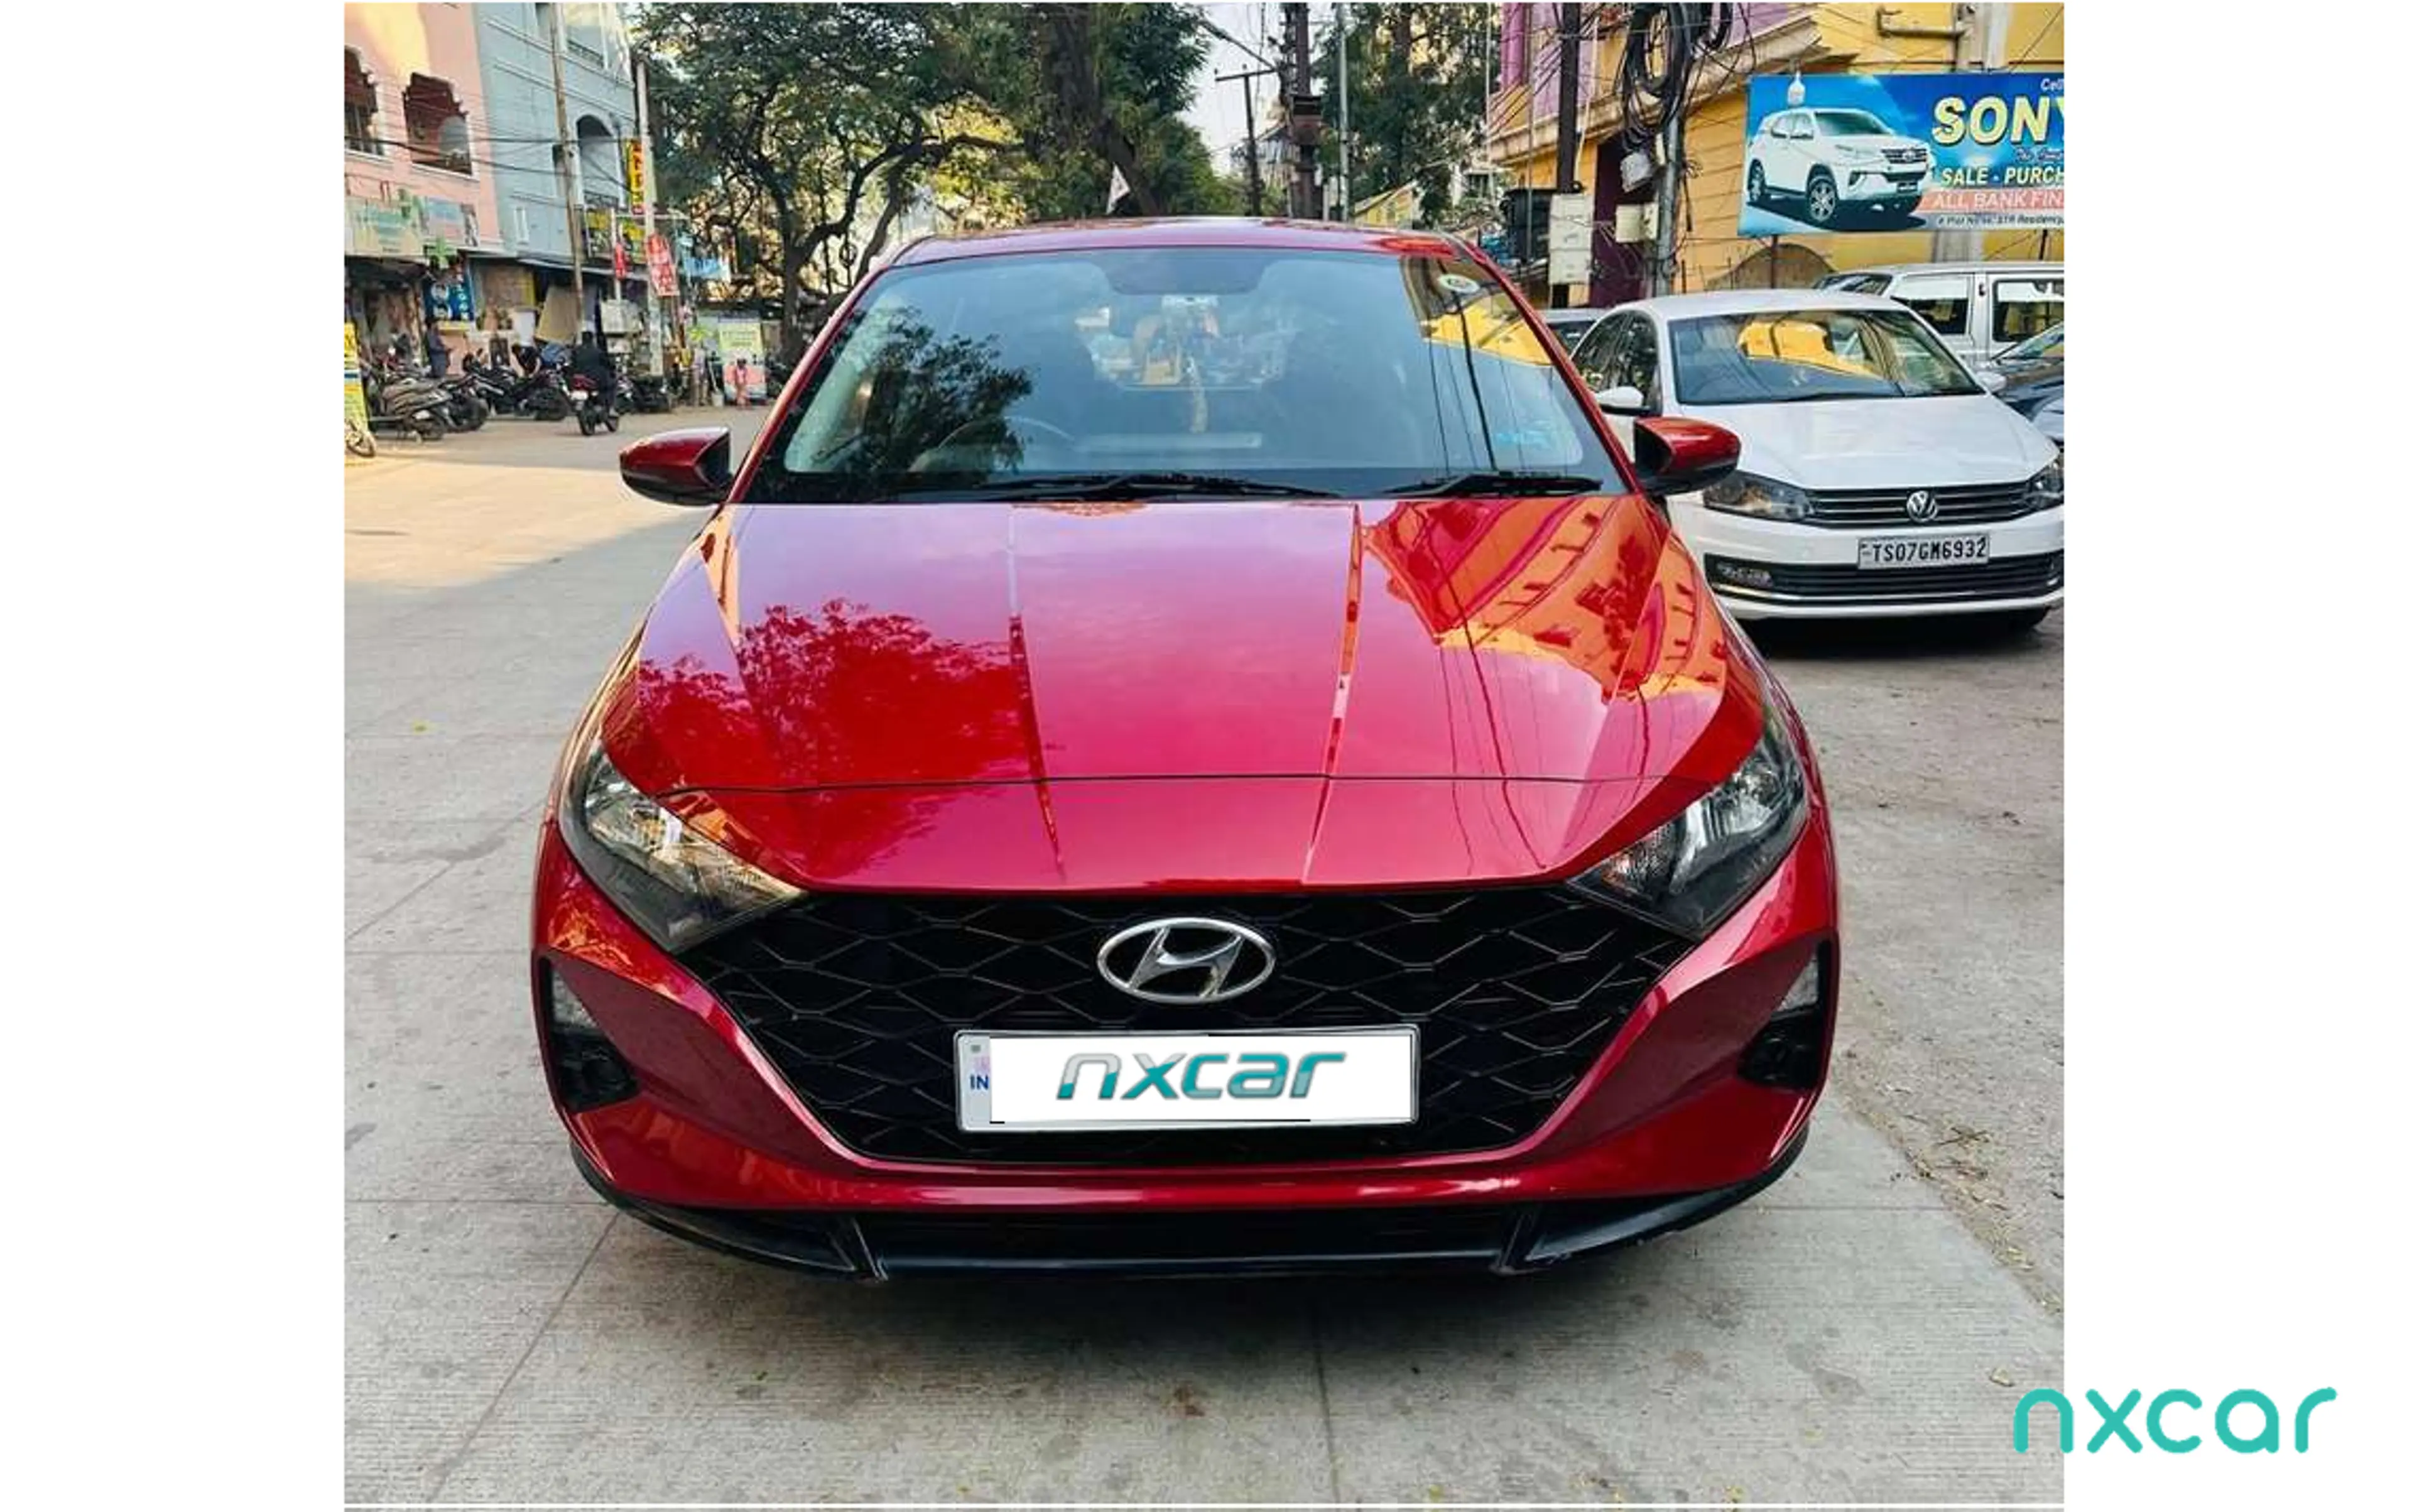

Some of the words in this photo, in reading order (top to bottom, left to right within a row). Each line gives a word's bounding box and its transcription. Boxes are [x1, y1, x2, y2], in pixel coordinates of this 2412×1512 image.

[1942, 167, 1989, 185] SALE
[1933, 193, 1970, 209] ALL
[1974, 191, 2025, 208] BANK
[1873, 536, 1986, 562] TS07GM6932
